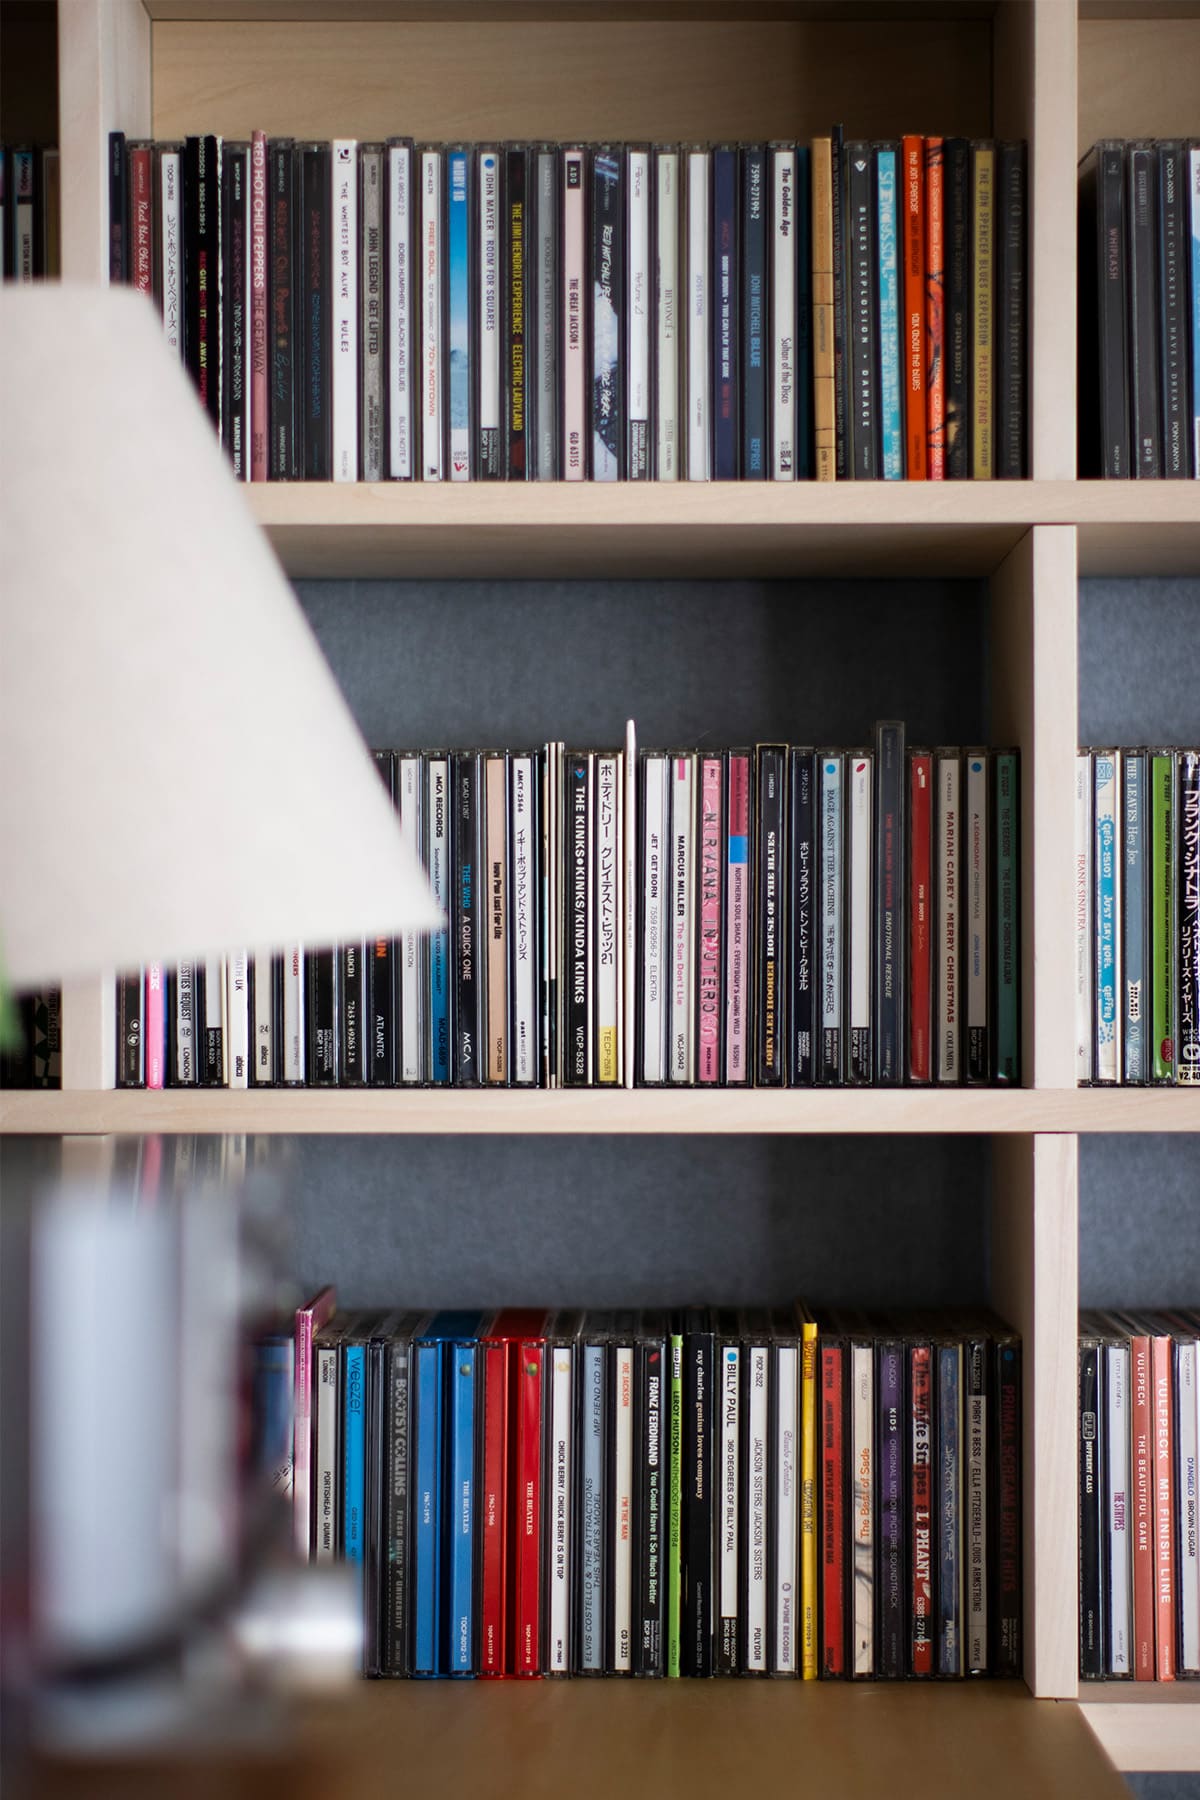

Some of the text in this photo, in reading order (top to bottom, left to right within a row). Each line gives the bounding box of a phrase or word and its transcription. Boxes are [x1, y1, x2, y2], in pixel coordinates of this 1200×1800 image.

[780, 168, 791, 236] The Golden Age
[254, 142, 264, 375] RED HOT CHILI PEPPERS THE GETAWAY
[486, 173, 496, 331] JOHN MAYER ROOM FOR SQUARES
[369, 228, 380, 354] JOHN LEGEND GET LIFTED
[570, 279, 578, 290] THE
[511, 203, 523, 430] THE JIMI HENDRIX EXPERIENCE ELECTRIC LADYLAND
[570, 293, 578, 313] GREAT
[570, 315, 578, 343] JACKSON
[780, 338, 792, 359] Sultan
[780, 370, 792, 383] the
[780, 384, 791, 404] Disco
[632, 423, 640, 478] COMMUNICATIONS
[576, 786, 585, 811] THE
[1127, 759, 1138, 864] THE LEAVES Hey Joe
[768, 900, 774, 915] OF
[826, 875, 834, 917] MACHINE
[1077, 855, 1086, 930] FRANK SINATRA
[703, 813, 718, 1013] NIRVANA IN UTERO
[649, 925, 657, 959] 62956-2
[575, 962, 584, 1003] KINKS
[181, 992, 191, 1021] REQUEST
[576, 1026, 584, 1074] VICP-5328
[349, 1357, 362, 1414] weezer
[648, 1377, 658, 1408] FRANZ
[1136, 1352, 1145, 1406] VULFPECK
[671, 1391, 680, 1416] LEROY
[727, 1364, 736, 1427] BILLY PAUL
[696, 1402, 704, 1432] genius
[973, 1399, 982, 1424] PORGY
[648, 1411, 659, 1465] FERDINAND
[972, 1437, 982, 1456] BESS
[1137, 1435, 1145, 1454] THE
[753, 1438, 762, 1472] JACKSON
[649, 1472, 658, 1486] You
[672, 1457, 681, 1505] ANTHOLOGY
[972, 1468, 981, 1487] ELLA
[1159, 1378, 1172, 1603] VULFPECK MR FINISH LINE
[1186, 1458, 1194, 1497] D'ANGELO
[324, 1471, 332, 1550] PORTISHEAD DUMMY
[649, 1488, 658, 1510] Could
[727, 1494, 734, 1505] OF
[1114, 1492, 1125, 1530] THE STRYPES
[649, 1513, 657, 1532] Have
[672, 1508, 680, 1547] 1972-1984
[556, 1544, 564, 1552] IS
[556, 1554, 564, 1563] ON
[649, 1543, 657, 1553] So
[649, 1555, 657, 1577] Much
[753, 1550, 762, 1580] SISTERS
[649, 1579, 657, 1603] Better
[972, 1567, 982, 1611] ARMSTRONG
[753, 1628, 762, 1660] POLYDOR
